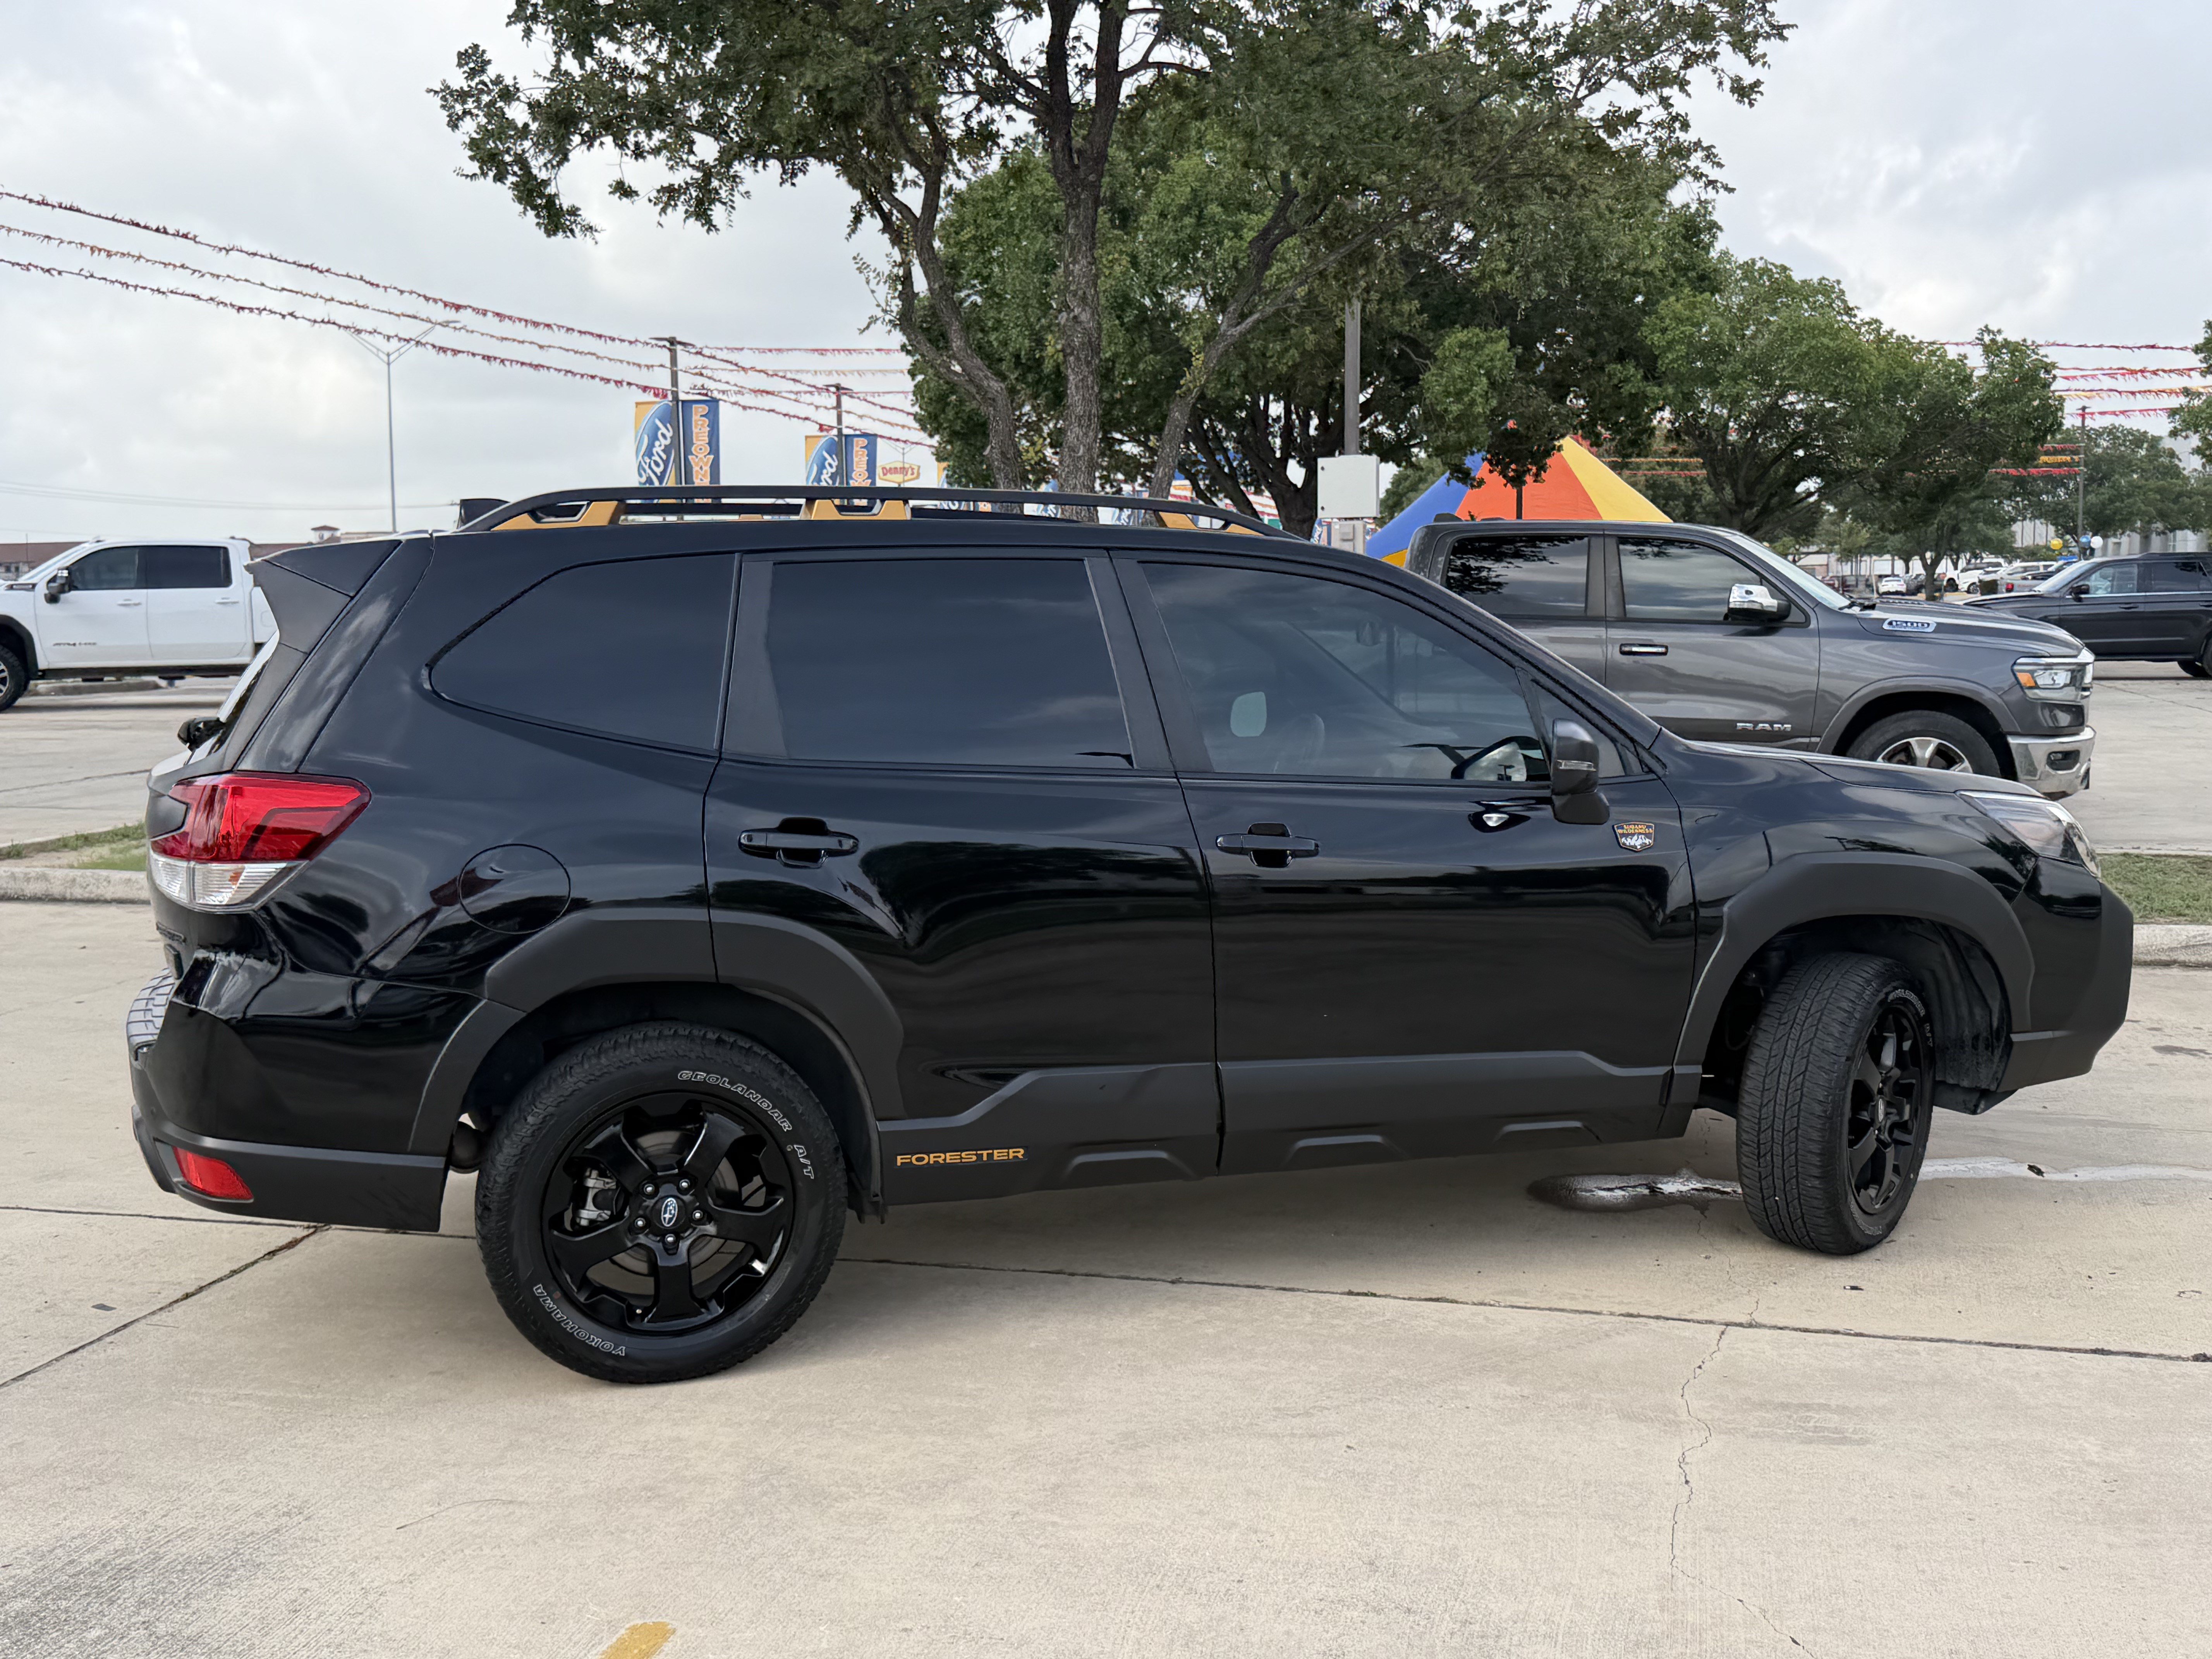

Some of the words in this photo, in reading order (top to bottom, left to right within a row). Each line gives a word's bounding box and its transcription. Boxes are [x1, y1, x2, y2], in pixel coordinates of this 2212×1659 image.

[881, 466, 915, 477] Denny's
[1736, 723, 1791, 732] RAM
[677, 1070, 792, 1132] GEOLANDAR
[793, 1144, 814, 1179] A/T
[896, 1148, 1025, 1166] FORESTER
[533, 1284, 626, 1357] YOKOHAMA
